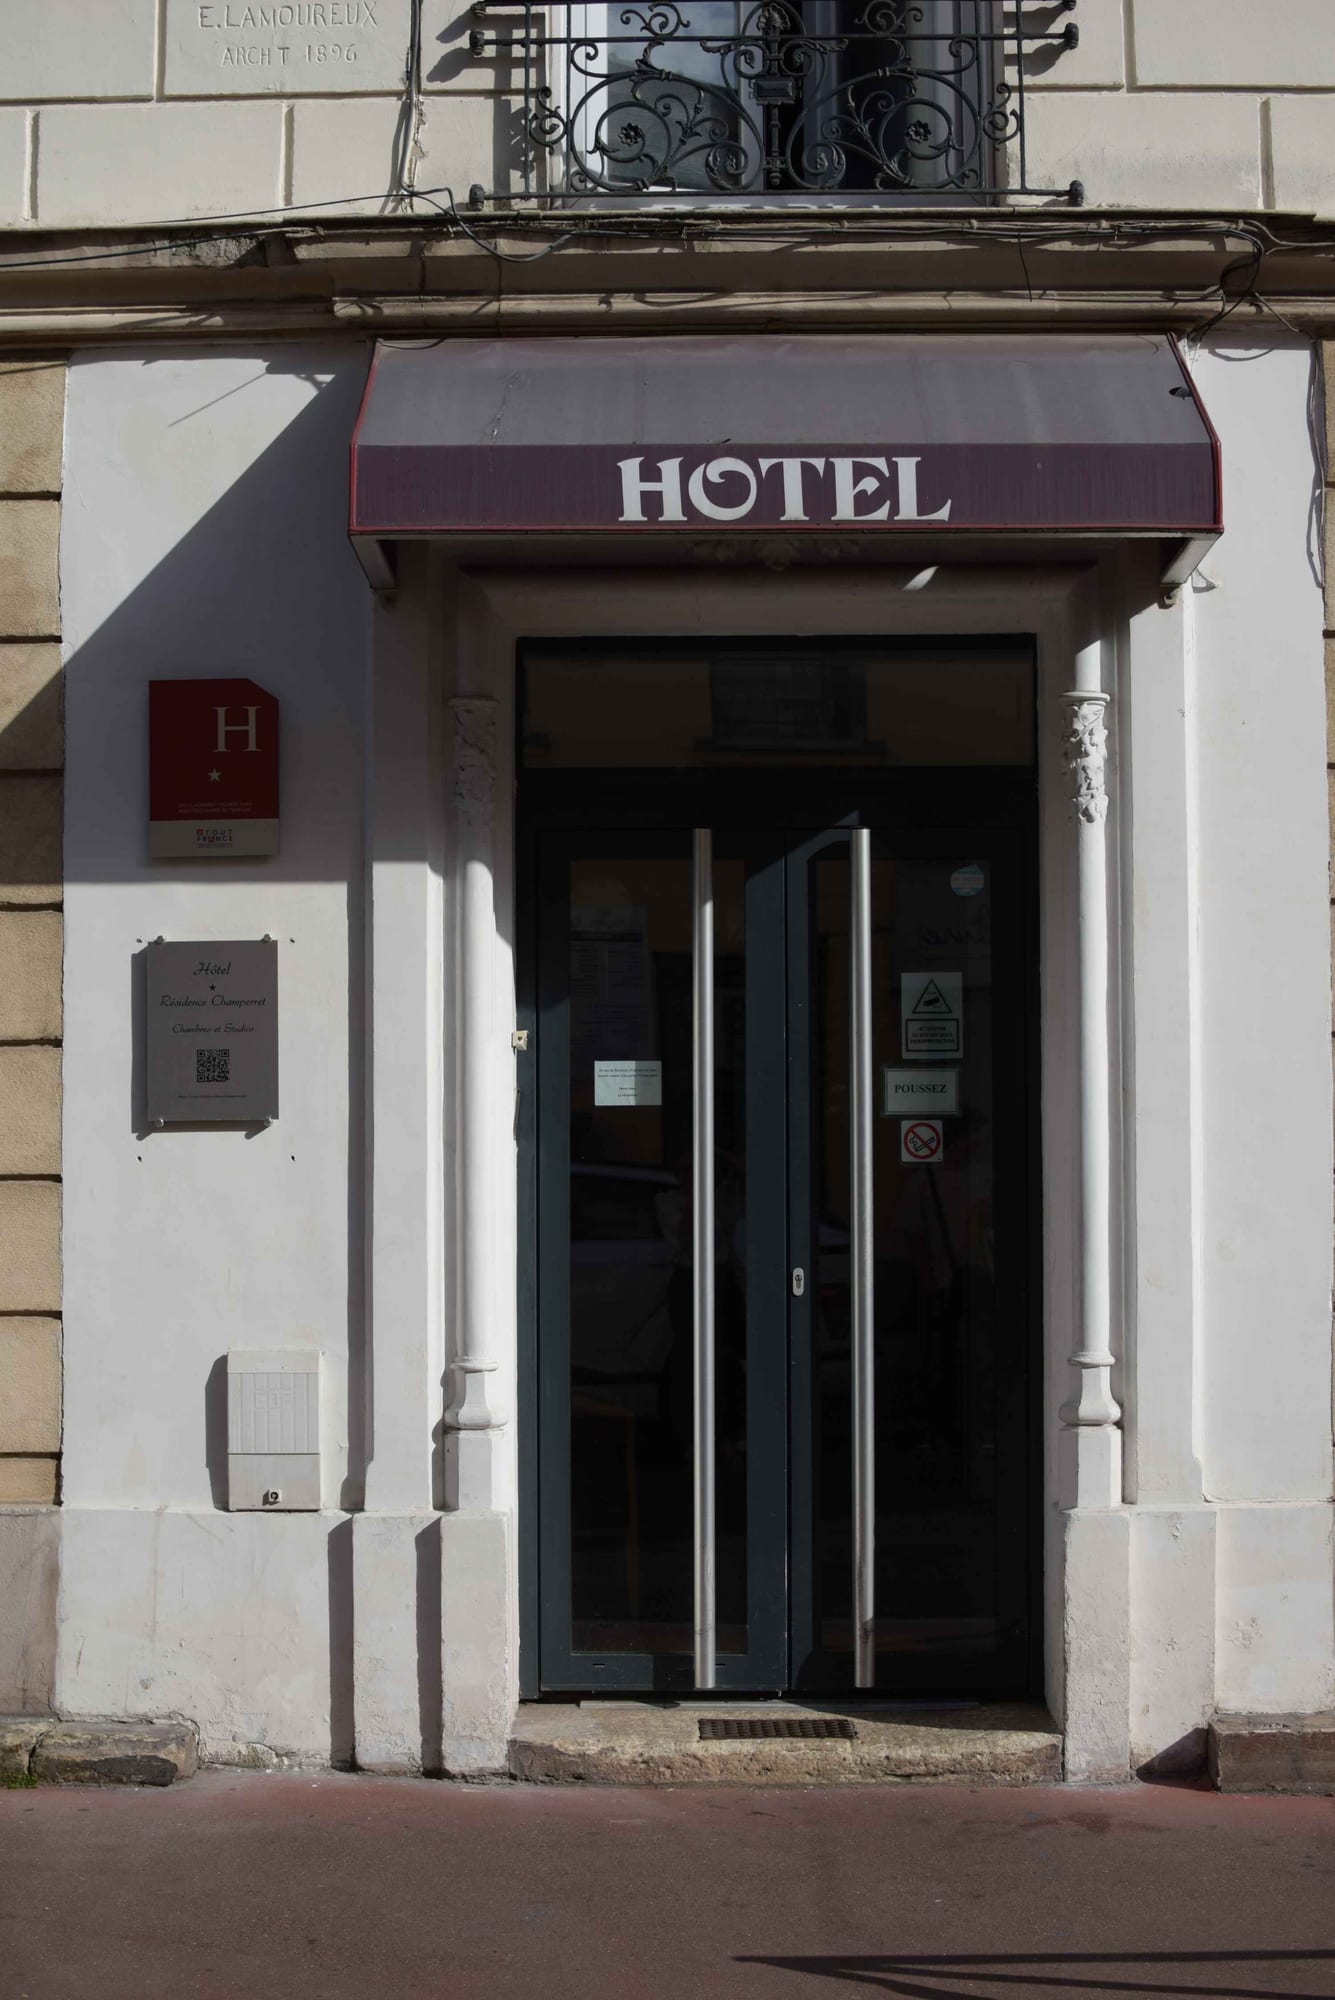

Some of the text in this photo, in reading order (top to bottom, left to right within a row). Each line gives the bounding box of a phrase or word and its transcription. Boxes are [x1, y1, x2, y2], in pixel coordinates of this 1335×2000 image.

[305, 43, 358, 64] 1896
[616, 456, 952, 522] HOTEL
[210, 704, 262, 752] H
[193, 961, 231, 976] Hôtel
[160, 994, 266, 1008] Résidence Champerret
[895, 1084, 947, 1093] POUSSEZ
